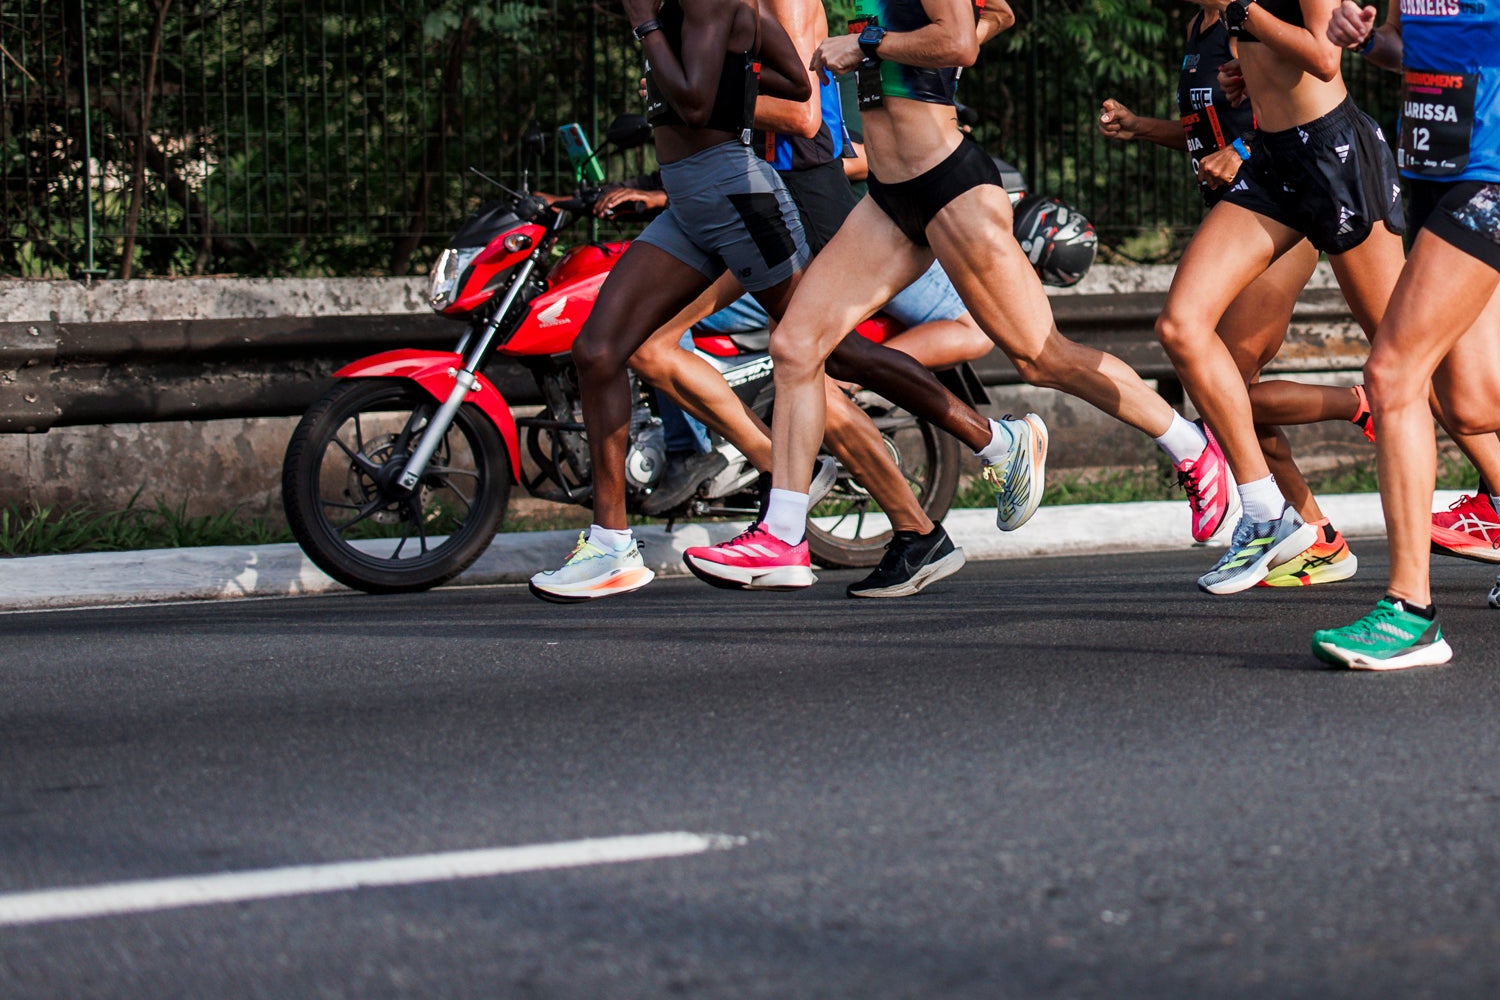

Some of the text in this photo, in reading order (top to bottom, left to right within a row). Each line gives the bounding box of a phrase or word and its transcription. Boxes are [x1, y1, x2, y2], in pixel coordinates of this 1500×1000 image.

[1404, 101, 1458, 122] LARISSA
[1187, 138, 1204, 152] BIA
[1412, 127, 1430, 151] 12
